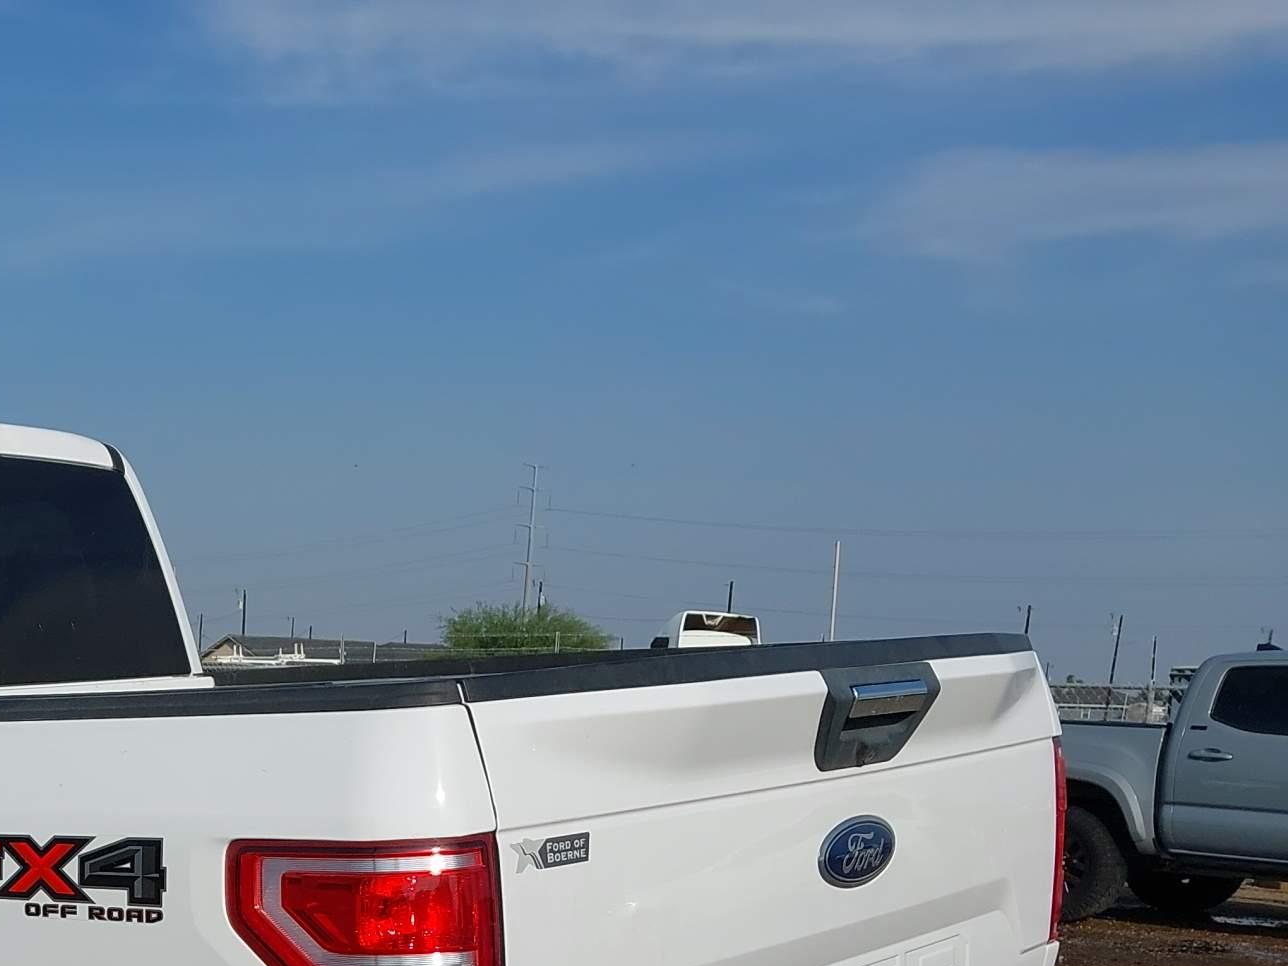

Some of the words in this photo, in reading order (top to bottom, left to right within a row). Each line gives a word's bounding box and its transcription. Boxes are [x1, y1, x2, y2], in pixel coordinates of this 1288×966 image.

[546, 841, 571, 853] FORD
[573, 838, 586, 848] OF
[836, 831, 884, 874] Ford
[547, 848, 587, 863] BOERNE
[24, 902, 78, 919] OFF
[87, 905, 164, 924] ROAD
